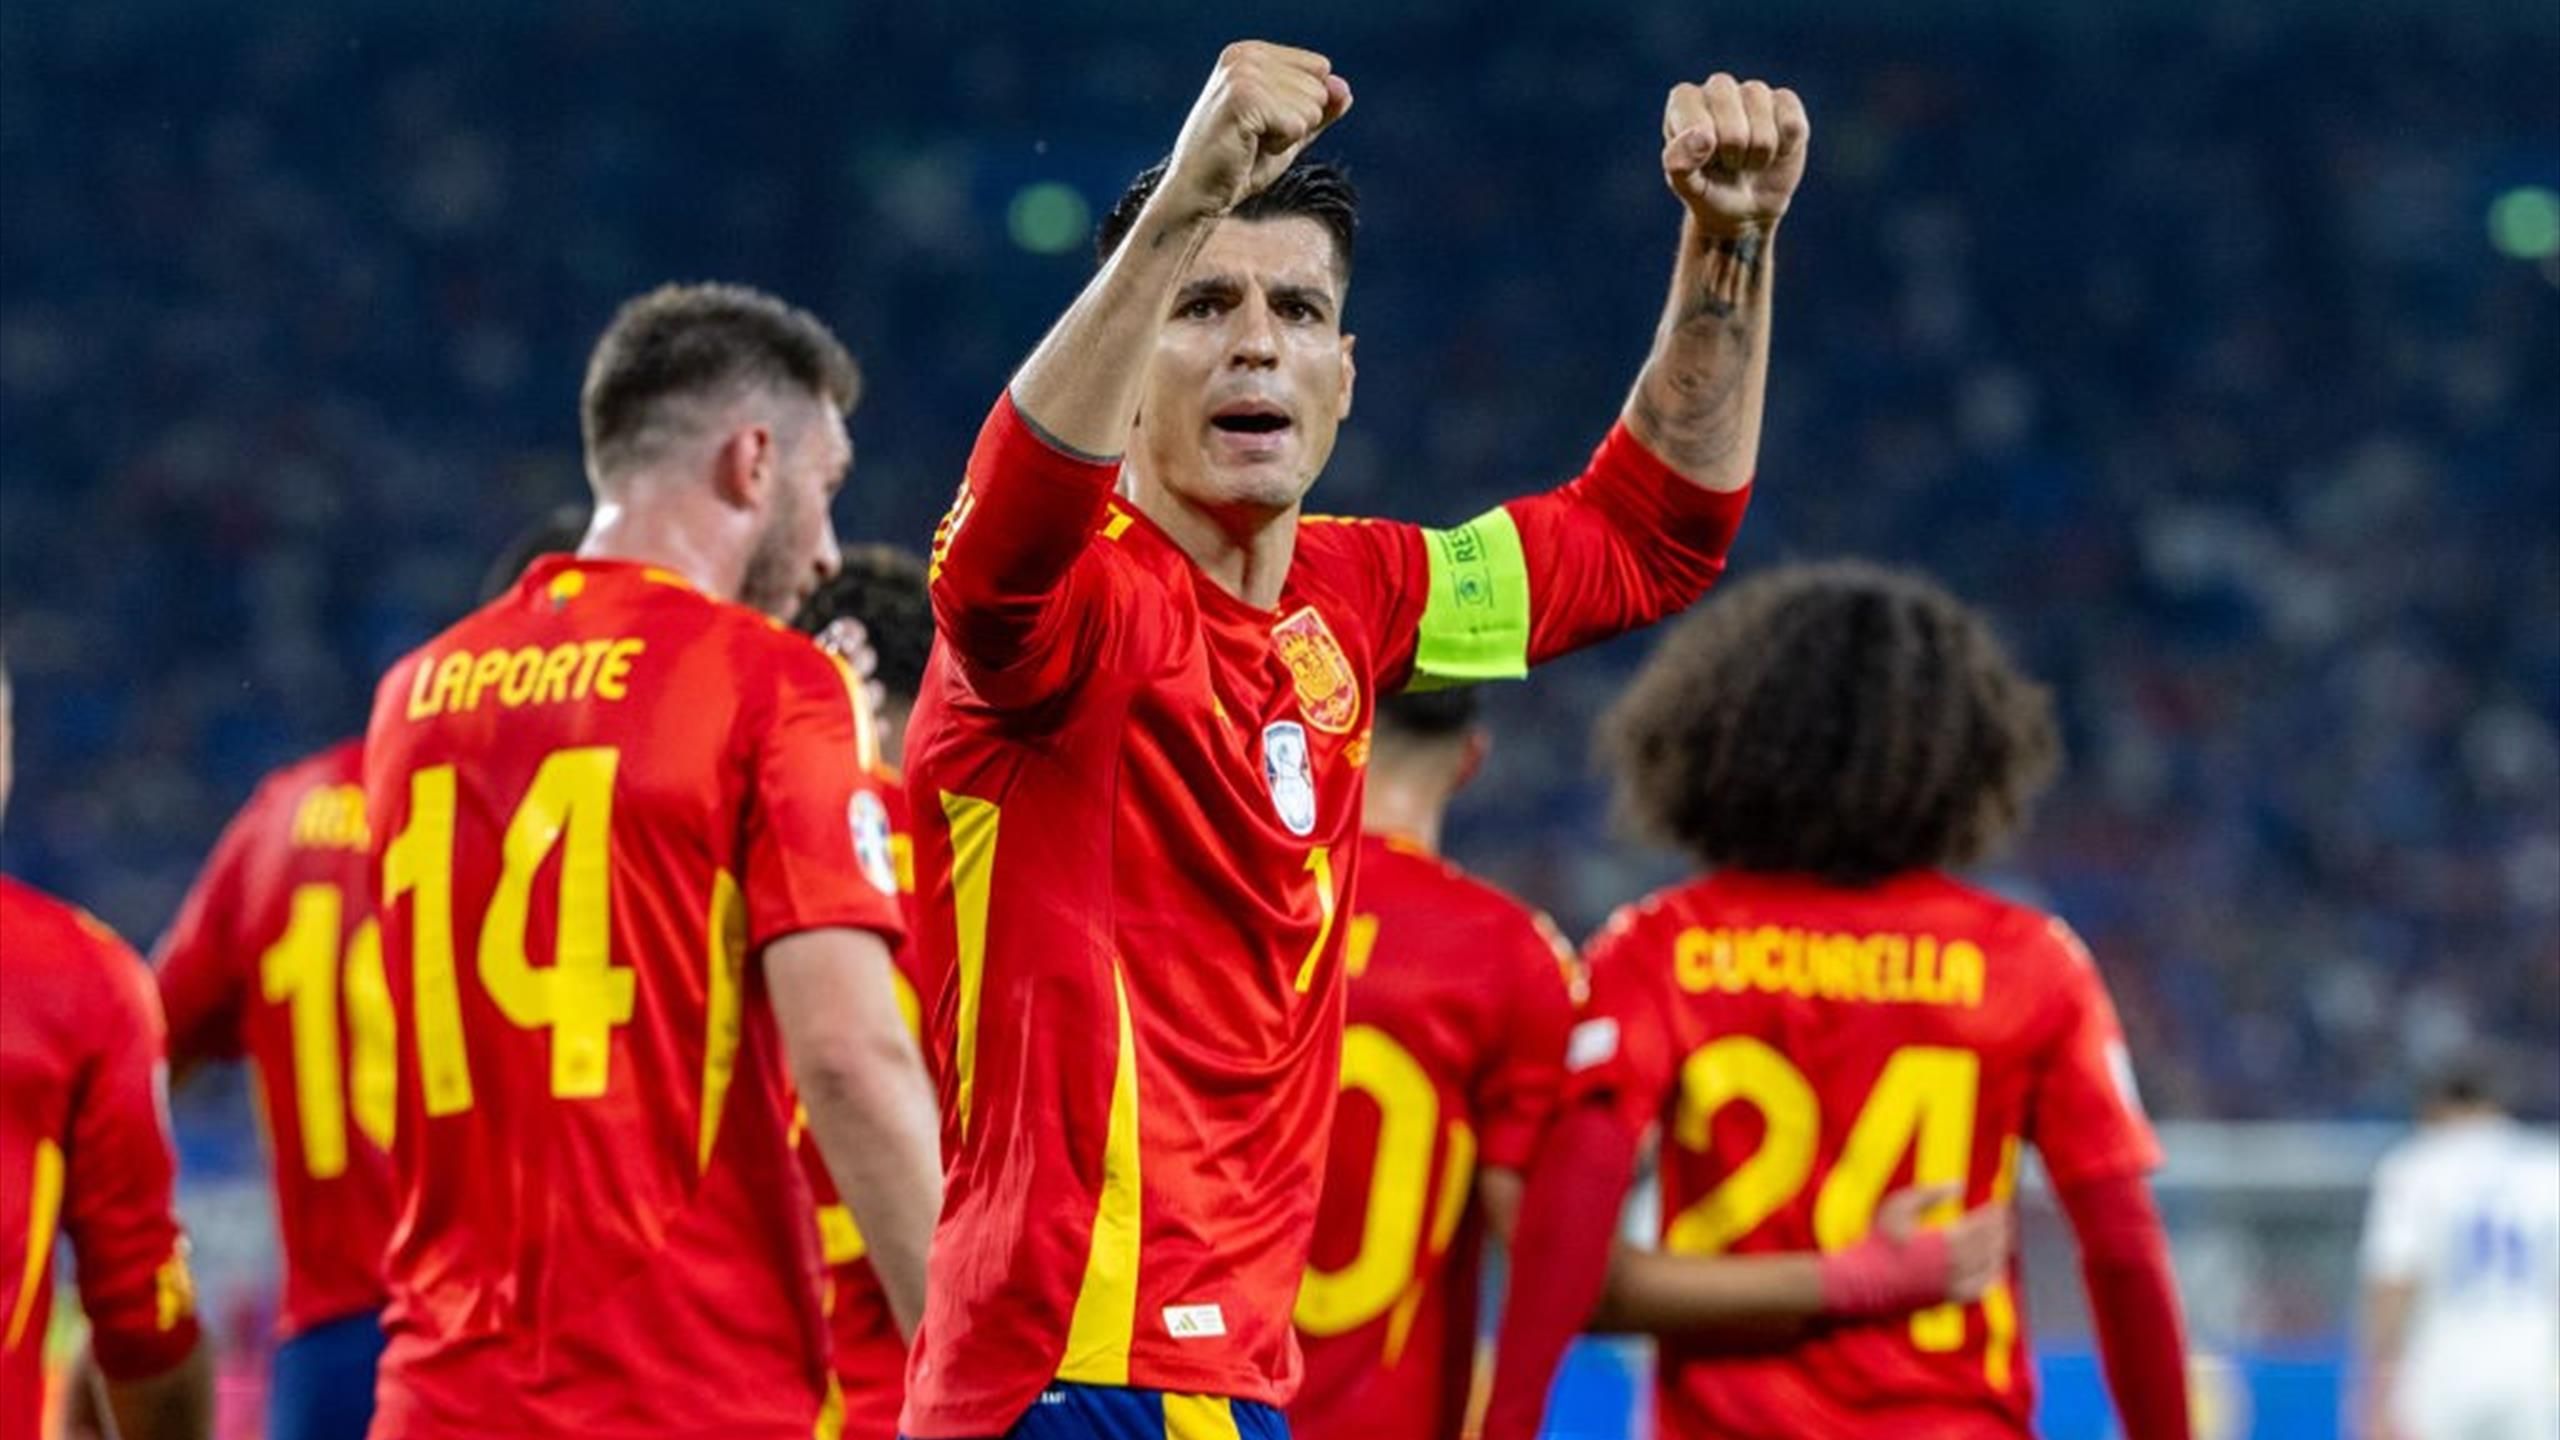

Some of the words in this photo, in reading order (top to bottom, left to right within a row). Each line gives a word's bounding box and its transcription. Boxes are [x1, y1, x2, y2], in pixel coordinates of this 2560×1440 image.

[408, 639, 645, 720] LAPORTE
[383, 747, 636, 1117] 14
[1674, 926, 1985, 1008] CUCURELLA
[1666, 1035, 1979, 1351] 24
